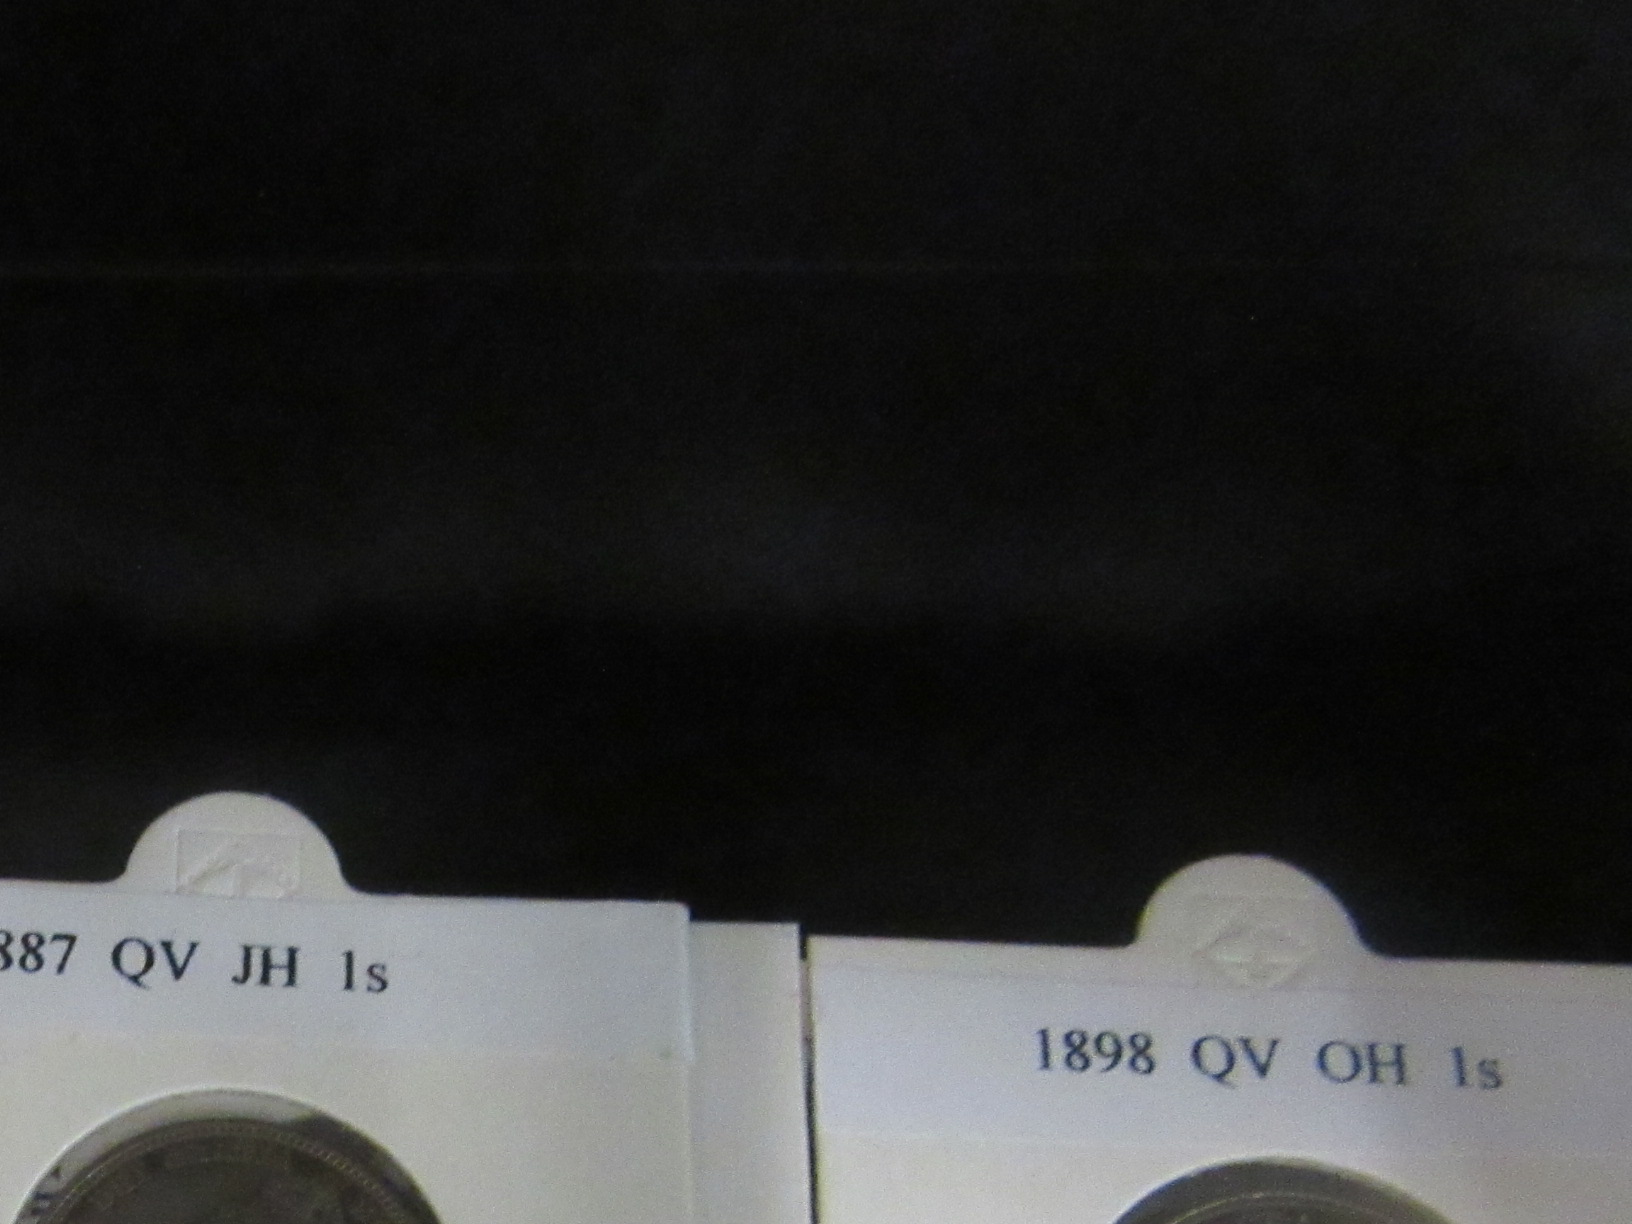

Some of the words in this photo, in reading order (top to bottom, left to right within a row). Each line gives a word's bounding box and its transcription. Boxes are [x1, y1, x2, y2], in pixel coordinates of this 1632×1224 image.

[110, 936, 200, 990] QV
[231, 943, 300, 988] JH
[341, 948, 390, 994] 1s
[1035, 1026, 1157, 1076] 1898
[1188, 1033, 1281, 1089] QV
[1314, 1038, 1410, 1087] OH
[1451, 1044, 1504, 1090] 1s
